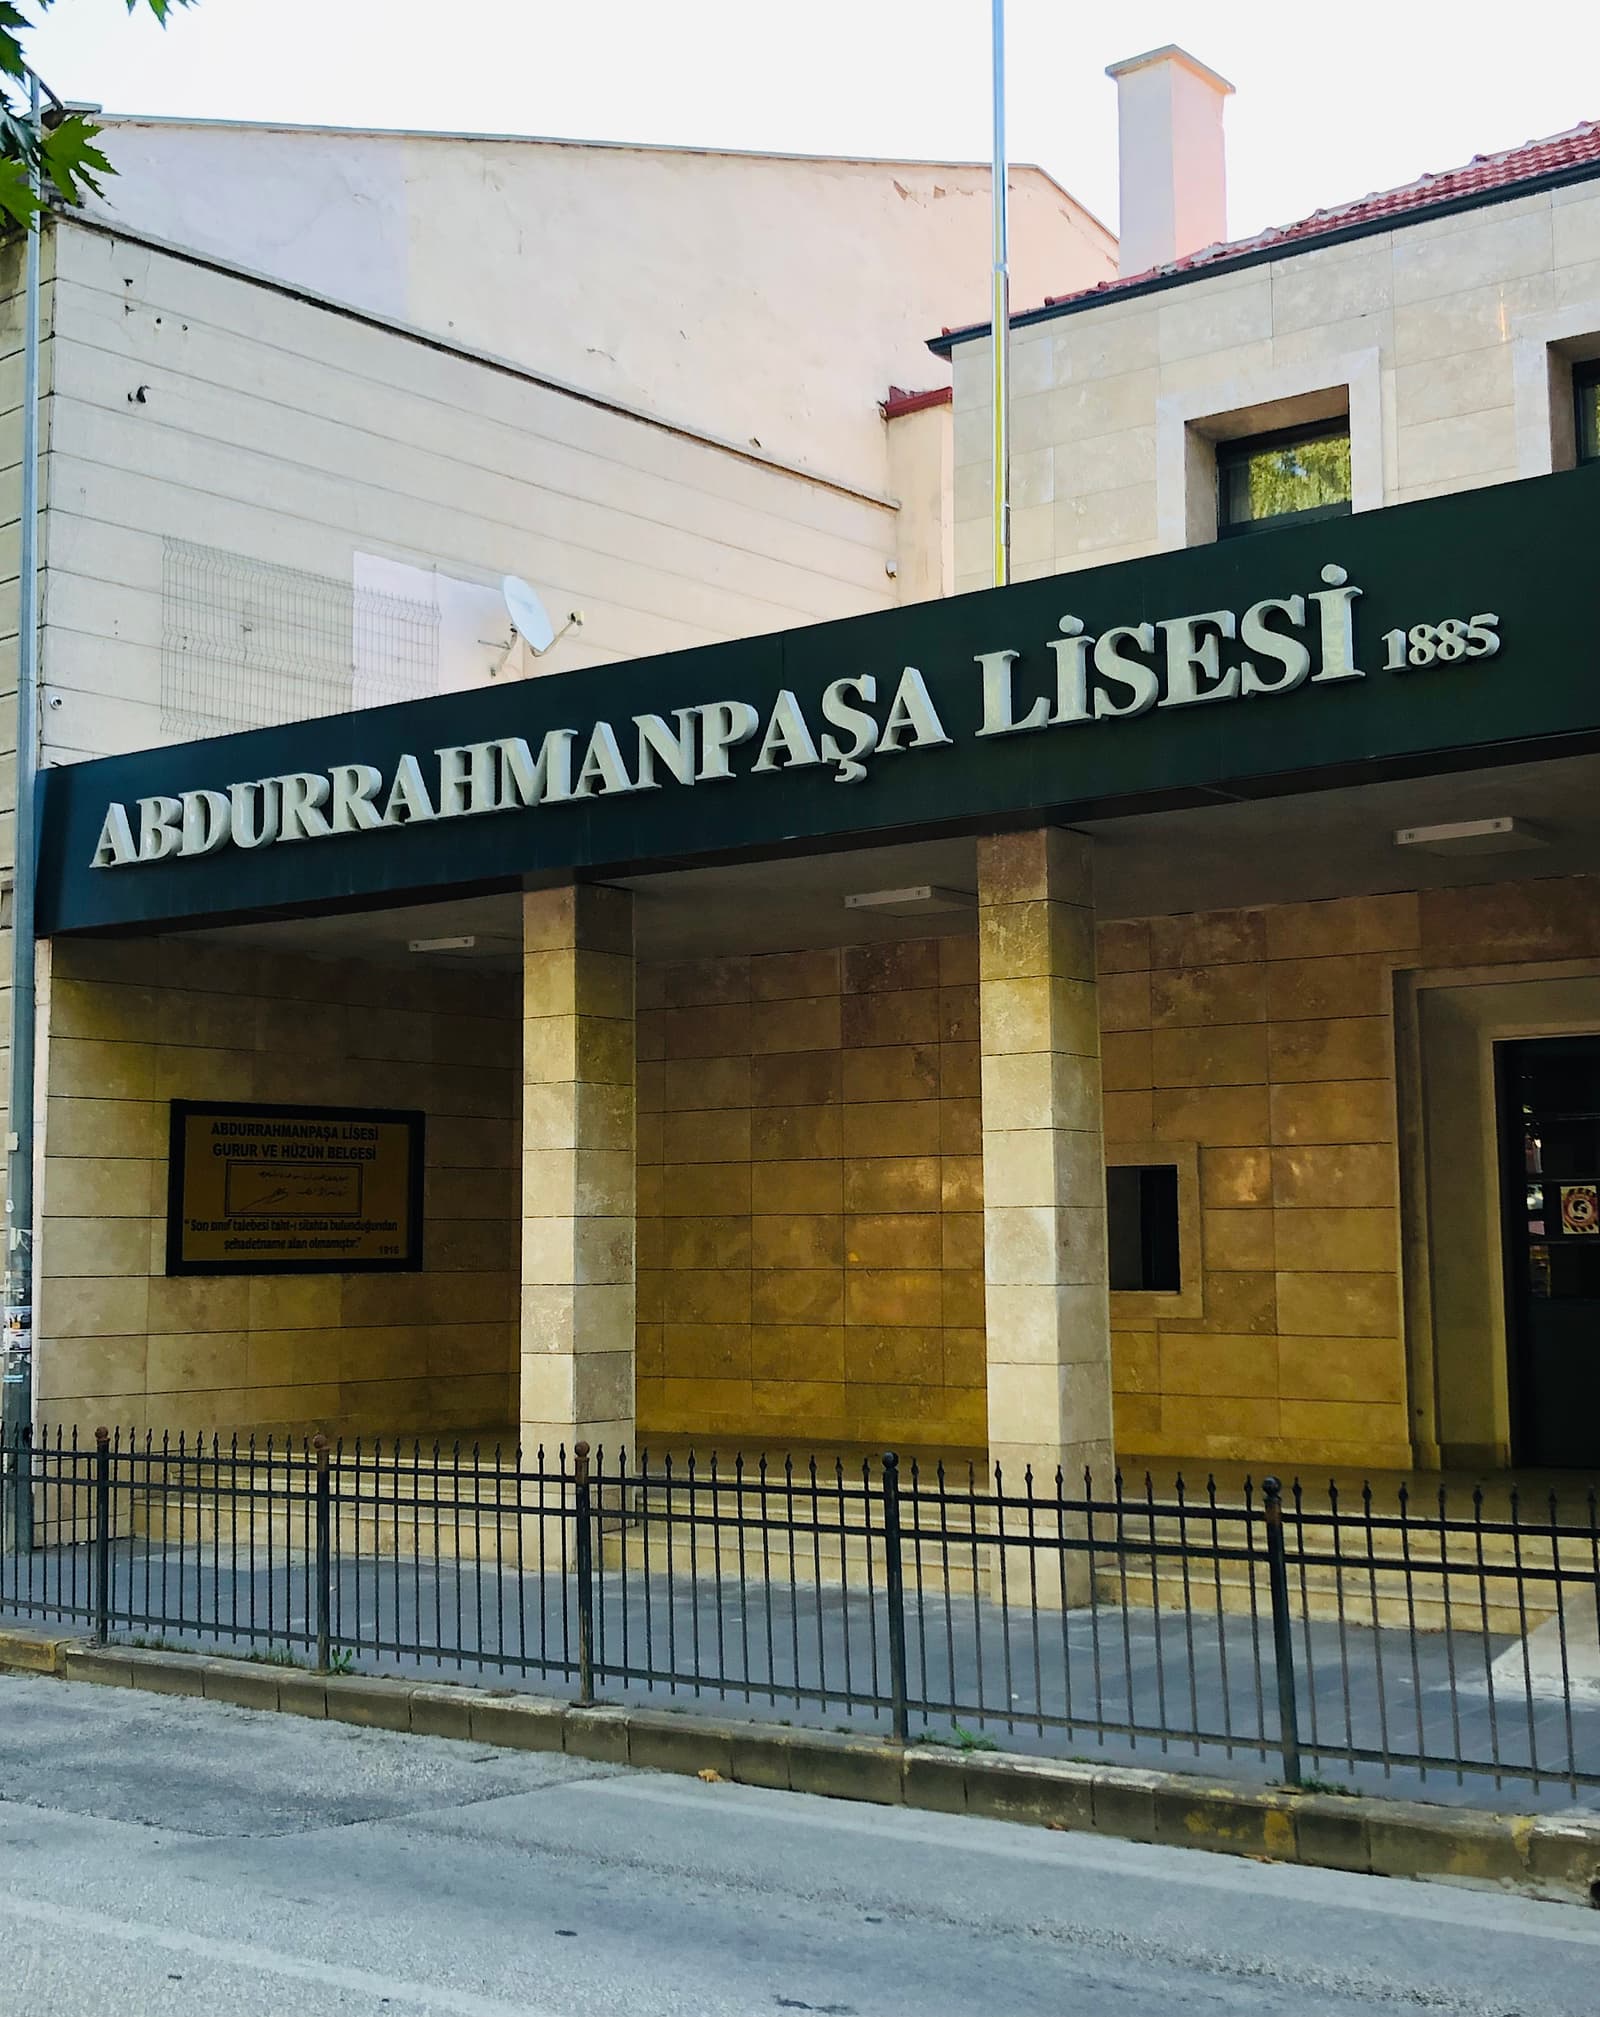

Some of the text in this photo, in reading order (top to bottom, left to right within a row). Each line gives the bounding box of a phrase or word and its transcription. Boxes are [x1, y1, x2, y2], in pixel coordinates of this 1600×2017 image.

[89, 564, 1500, 869] ABDURRAHMANPAŞA LİSESİ 1885
[211, 1122, 378, 1141] ABDURRAHMANPAŞA LİSESİ
[213, 1143, 376, 1160] GURUR VE HÜZÜN BELGESİ
